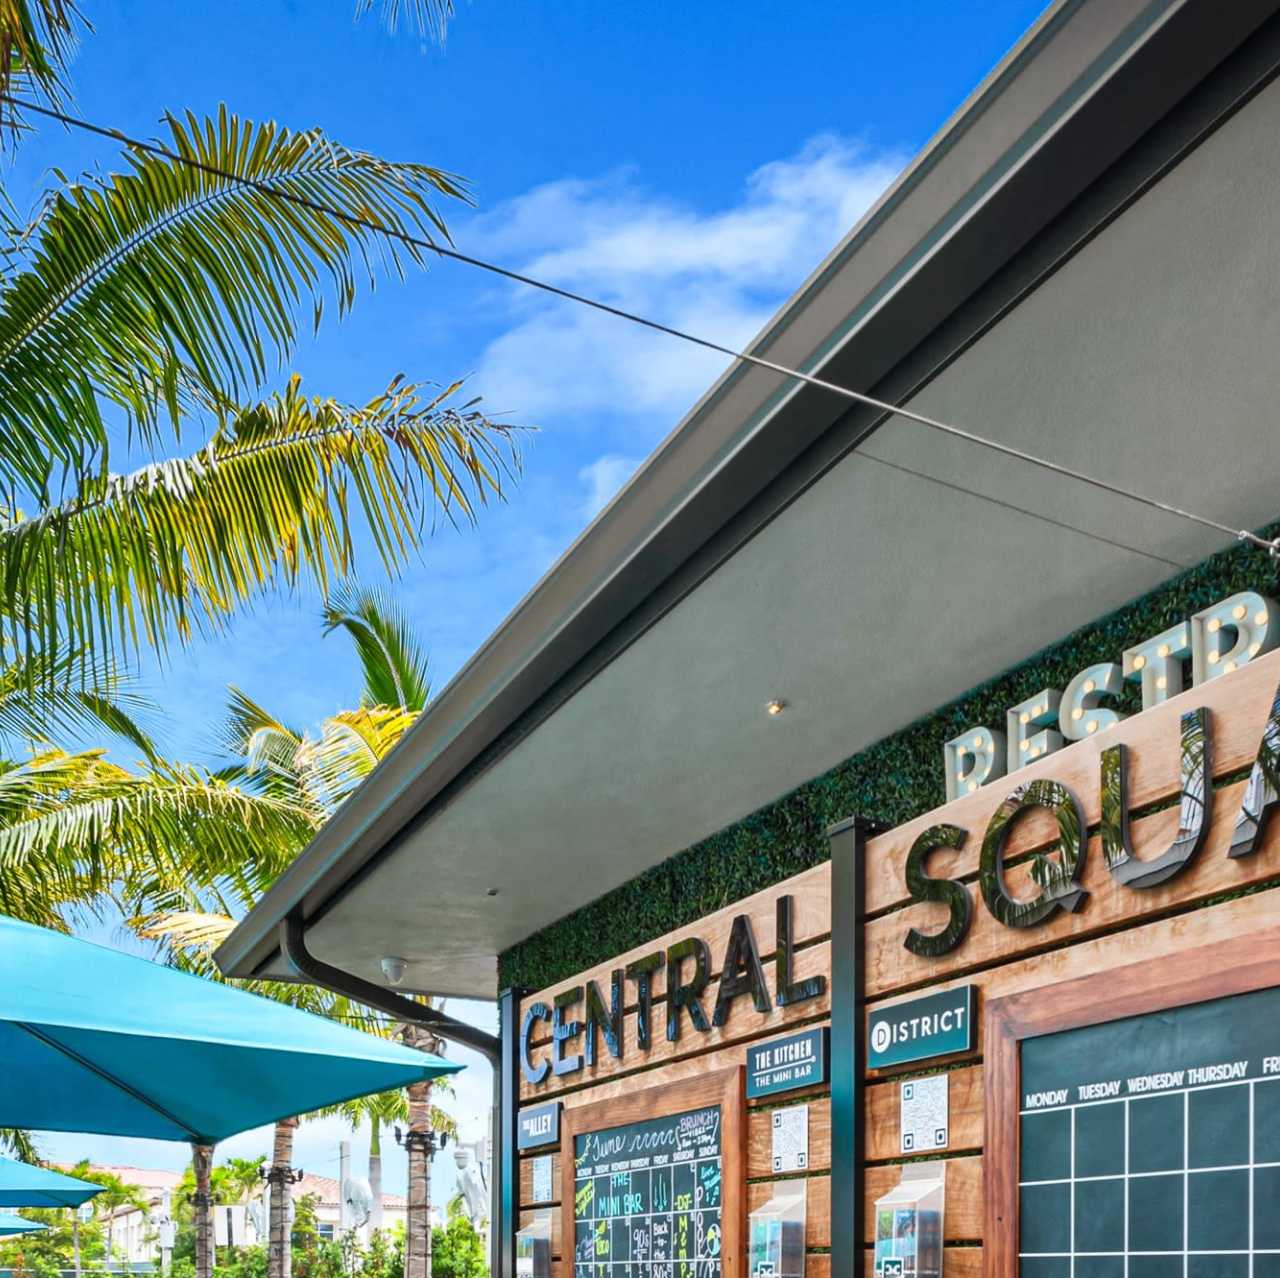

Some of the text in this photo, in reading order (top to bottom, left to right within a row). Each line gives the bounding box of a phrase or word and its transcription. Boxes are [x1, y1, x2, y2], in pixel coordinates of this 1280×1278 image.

[520, 894, 826, 1084] CENTRAL
[871, 1007, 965, 1053] DISTRICT
[755, 1038, 812, 1070] THE KITCHEN
[755, 1064, 812, 1087] THE MINI BAR
[1025, 1088, 1069, 1108] MONDAY
[1078, 1080, 1122, 1101] TUESDAY
[1127, 1071, 1185, 1093] WEDNESDAY
[1187, 1060, 1248, 1086] THURSDAY
[529, 1113, 552, 1137] ALLEY
[680, 1110, 713, 1132] BRUNCH
[592, 1134, 626, 1161] June
[598, 1195, 620, 1217] MINI
[623, 1193, 644, 1216] BAR
